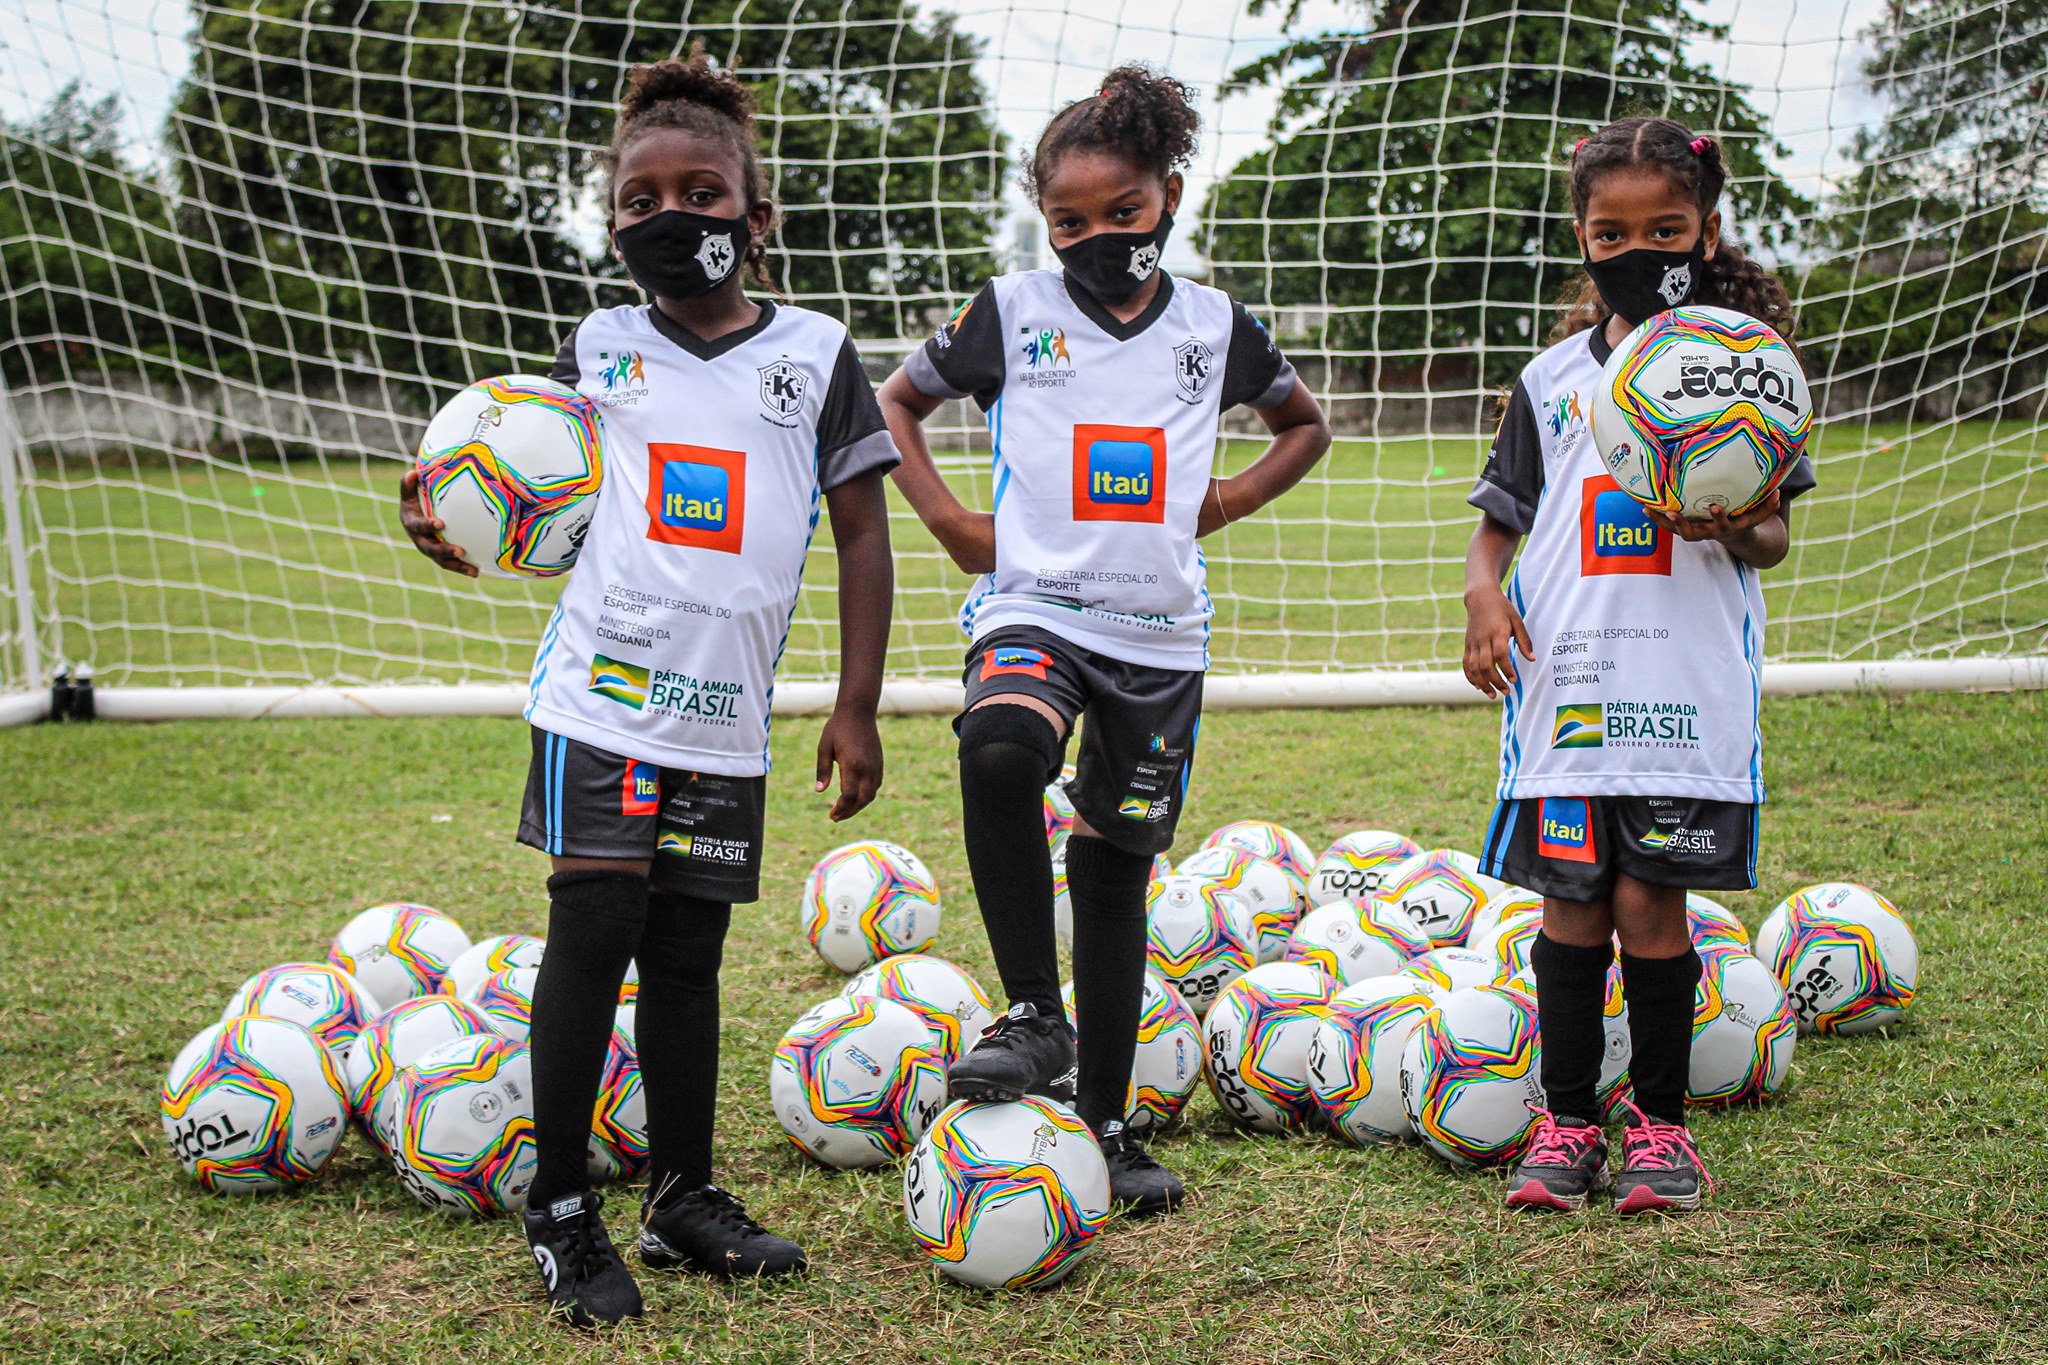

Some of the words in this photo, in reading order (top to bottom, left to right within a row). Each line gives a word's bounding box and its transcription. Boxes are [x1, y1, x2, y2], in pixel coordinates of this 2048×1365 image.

[1038, 370, 1076, 379] INCENTIVO
[1186, 354, 1206, 378] K
[773, 375, 797, 400] K
[1038, 379, 1066, 388] ESPORTE
[1093, 471, 1149, 495] Itaú
[665, 493, 723, 522] Itaú
[1598, 522, 1653, 547] Itaú
[1037, 579, 1081, 592] ESPORTE
[1038, 568, 1096, 582] SECRETARIA
[1098, 572, 1142, 584] ESPECIAL
[1144, 574, 1158, 584] DO
[603, 595, 649, 617] ESPORTE
[606, 584, 663, 606] SECRETARIA
[664, 598, 713, 617] ESPECIAL
[715, 607, 732, 619] DO
[599, 614, 654, 638] MINISTÉRIO
[656, 628, 671, 640] DA
[1086, 609, 1132, 626] GOVERNO
[1136, 622, 1173, 633] FEDERAL
[596, 626, 653, 649] CIDADANIA
[1553, 629, 1602, 644] SECRETARIA
[1604, 628, 1651, 639] ESPECIAL
[1653, 628, 1669, 639] DO
[1552, 643, 1588, 656] ESPORTE
[1553, 659, 1599, 674] MINISTÉRIO
[1601, 660, 1616, 671] DA
[654, 669, 698, 691] PÁTRIA
[701, 680, 744, 696] AMADA
[1554, 674, 1600, 687] CIDADANIA
[649, 683, 738, 719] BRASIL
[1606, 699, 1648, 714] PÁTRIA
[1651, 702, 1698, 717] AMADA
[647, 706, 693, 722] GOVERNO
[697, 717, 737, 728] FEDERAL
[1607, 716, 1699, 741] BRASIL
[1608, 740, 1650, 748] GOVERNO
[1656, 741, 1700, 750] FEDERAL
[636, 777, 658, 795] Ita
[1543, 818, 1584, 842] Itaú
[692, 843, 748, 861] BRASIL
[722, 840, 749, 848] AMADA
[1035, 1125, 1053, 1161] HYBRID
